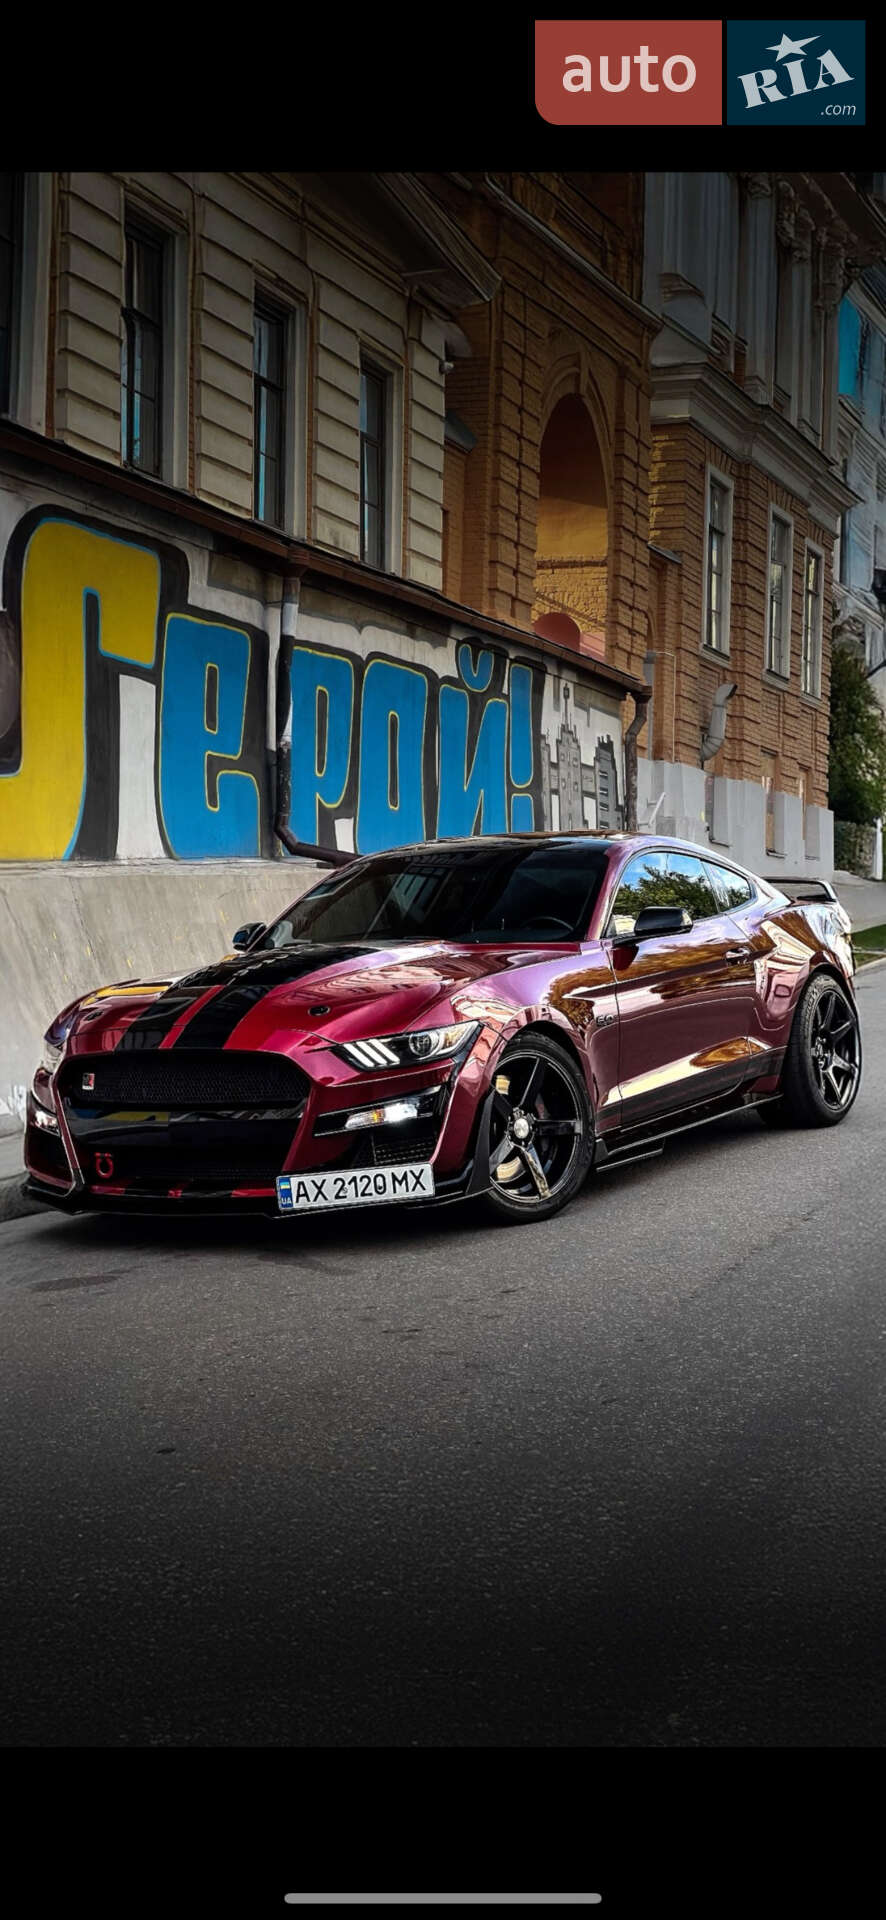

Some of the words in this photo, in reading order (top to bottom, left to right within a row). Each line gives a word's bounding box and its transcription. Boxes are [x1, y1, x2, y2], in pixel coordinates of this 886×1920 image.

[295, 1178, 329, 1204] AX
[333, 1172, 387, 1200] 2120
[391, 1168, 427, 1194] MX
[281, 1196, 292, 1205] UA
